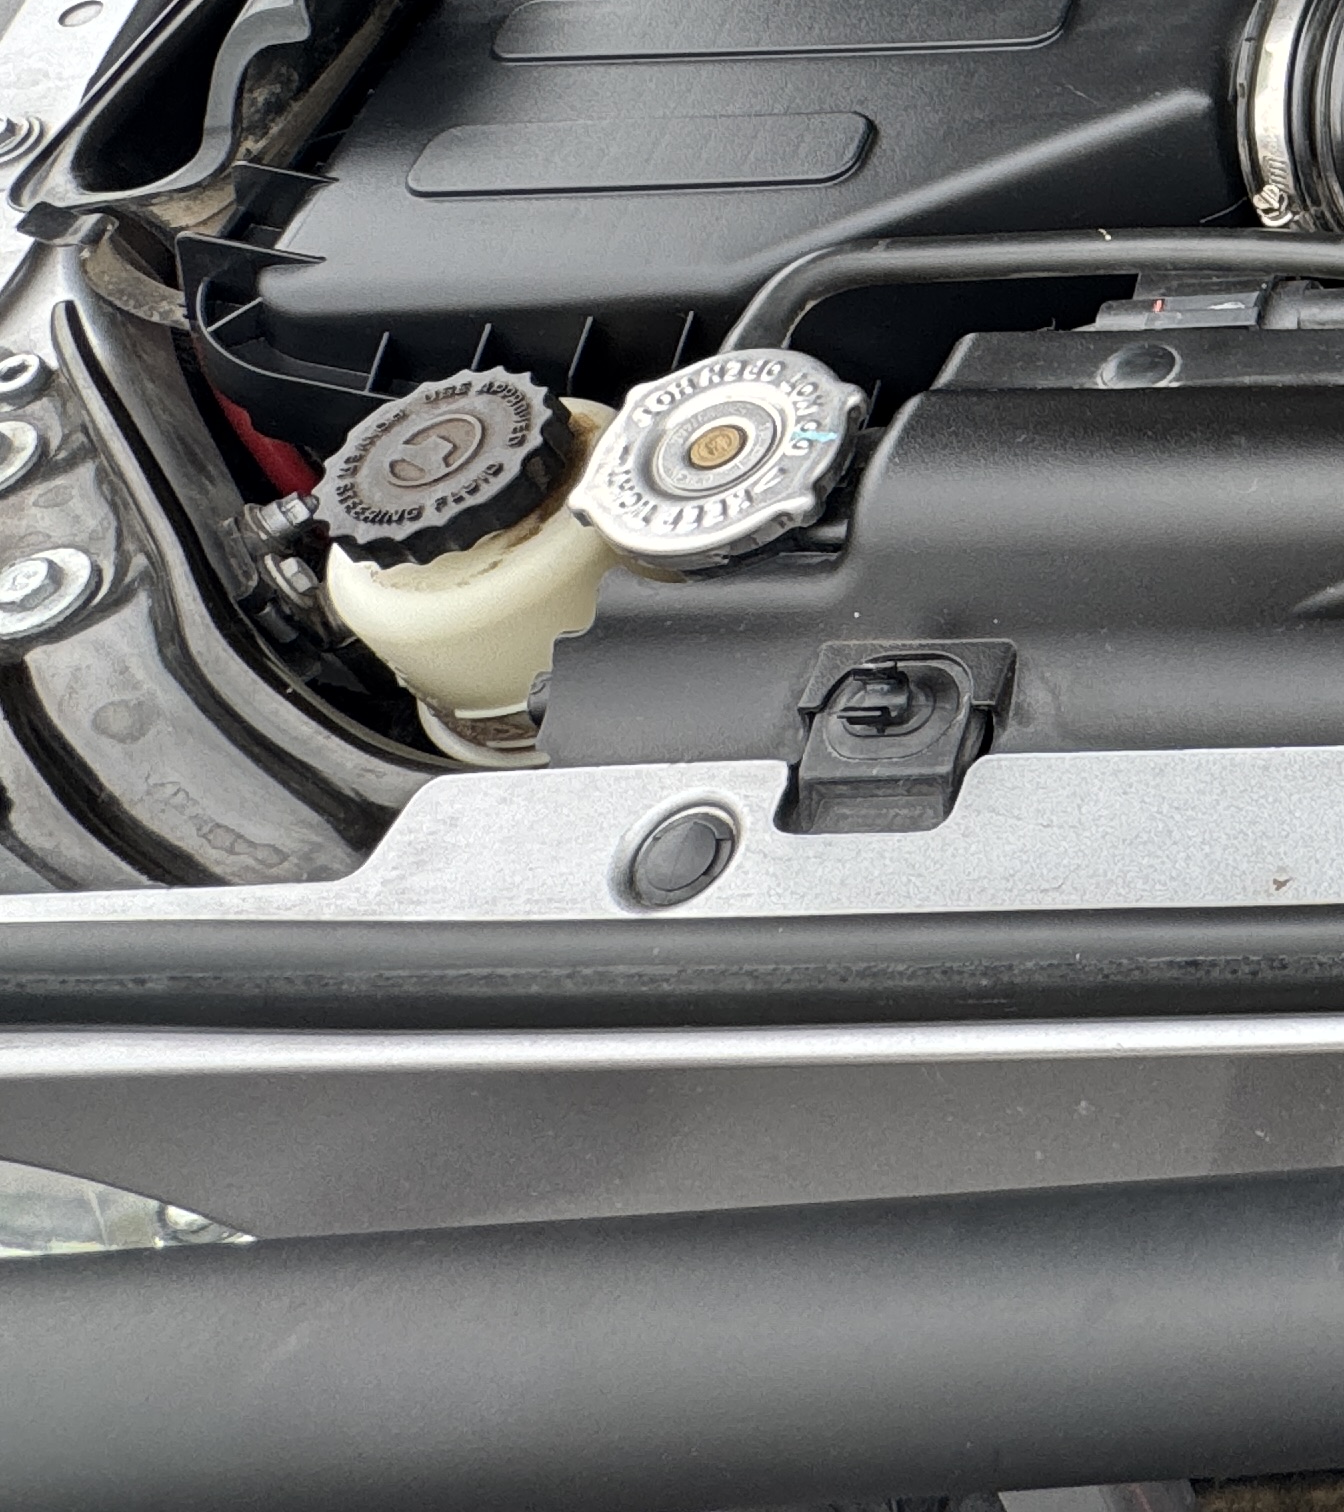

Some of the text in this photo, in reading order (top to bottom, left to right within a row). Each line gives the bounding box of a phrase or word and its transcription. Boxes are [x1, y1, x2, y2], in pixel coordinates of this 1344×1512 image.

[698, 358, 787, 389] OPEN
[424, 379, 533, 449] USE APPROVED
[631, 378, 698, 429] HOT
[335, 480, 425, 527] STEERING
[434, 461, 505, 513] FLUID
